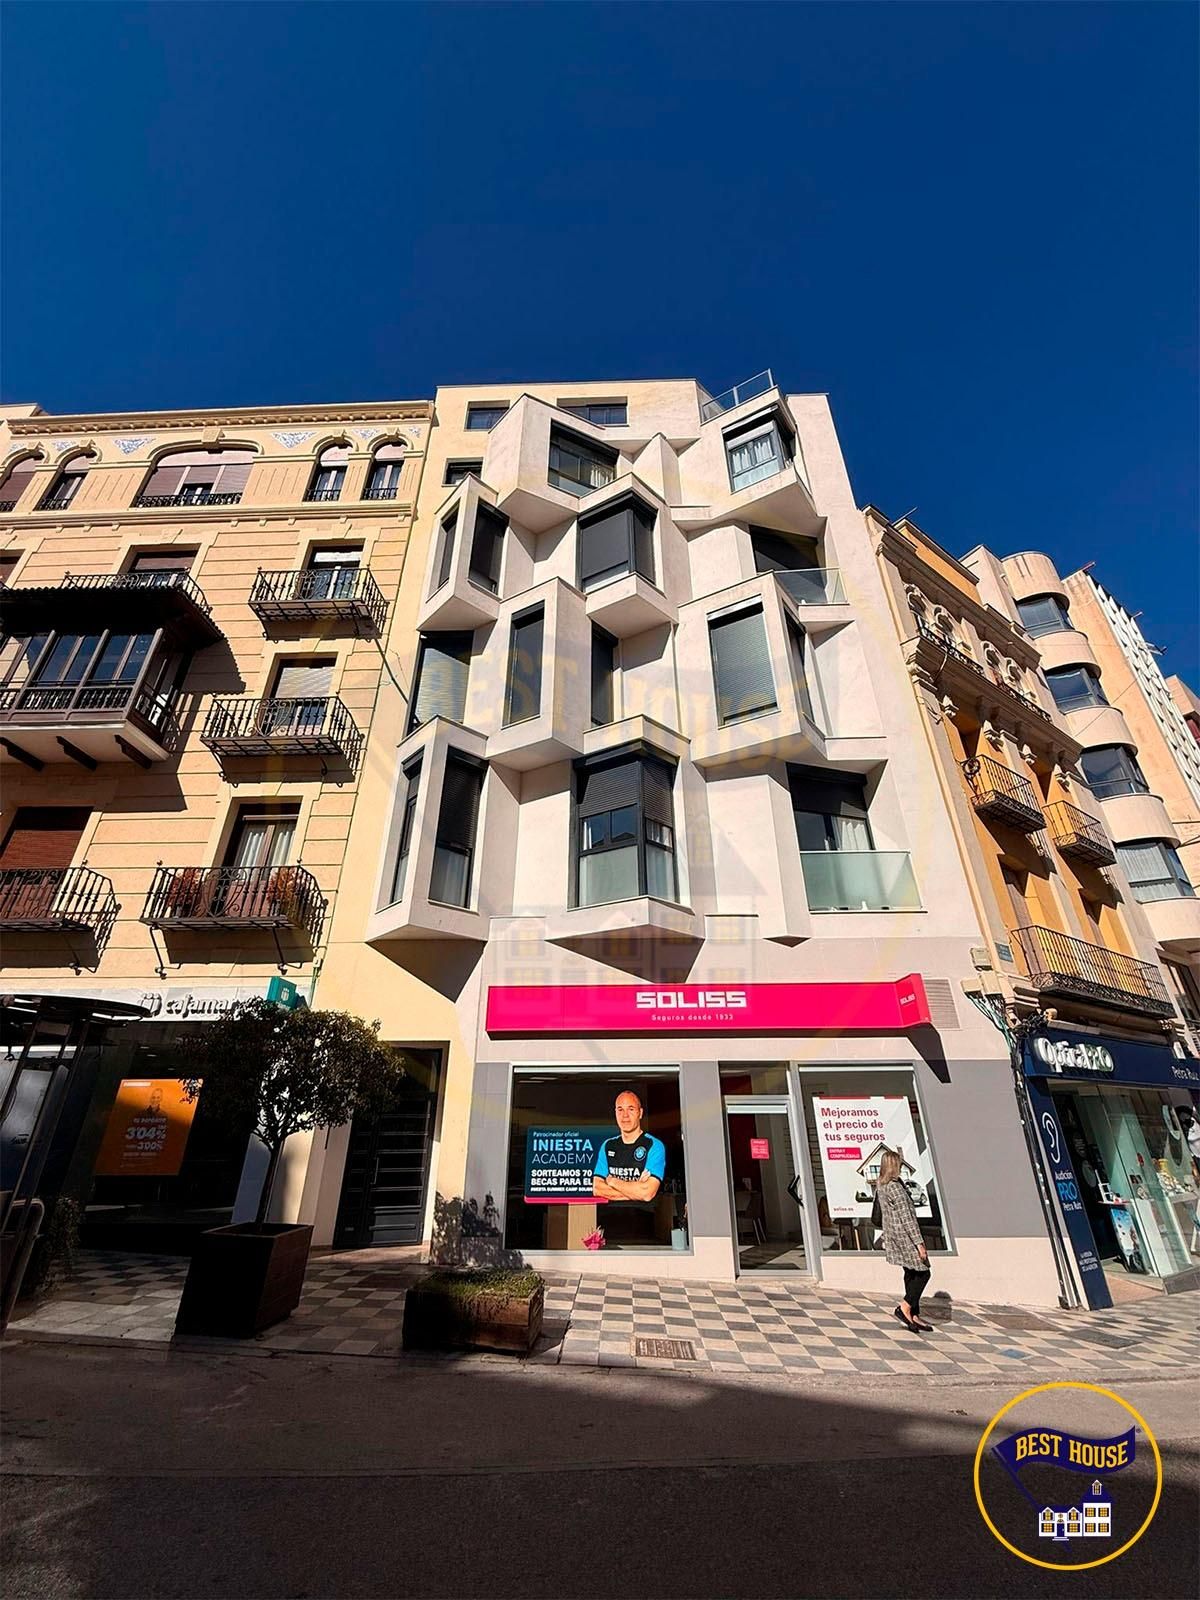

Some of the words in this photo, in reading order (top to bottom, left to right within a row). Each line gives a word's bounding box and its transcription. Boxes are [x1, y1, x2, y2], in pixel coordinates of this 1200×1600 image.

[636, 991, 748, 1008] SOLISS
[166, 994, 235, 1018] cajamar
[821, 1107, 879, 1119] Mejoramos
[823, 1120, 833, 1129] el
[835, 1120, 868, 1130] precio
[870, 1119, 884, 1129] de
[825, 1133, 842, 1141] tus
[844, 1133, 886, 1143] seguros
[533, 1139, 594, 1152] INIESTA
[531, 1153, 594, 1165] ACADEMY
[531, 1169, 580, 1178] SORTEAMOS
[582, 1169, 593, 1177] 70
[531, 1178, 558, 1186] BECAS
[559, 1178, 582, 1186] PARA
[583, 1178, 593, 1186] EL
[1057, 1181, 1078, 1201] PRO
